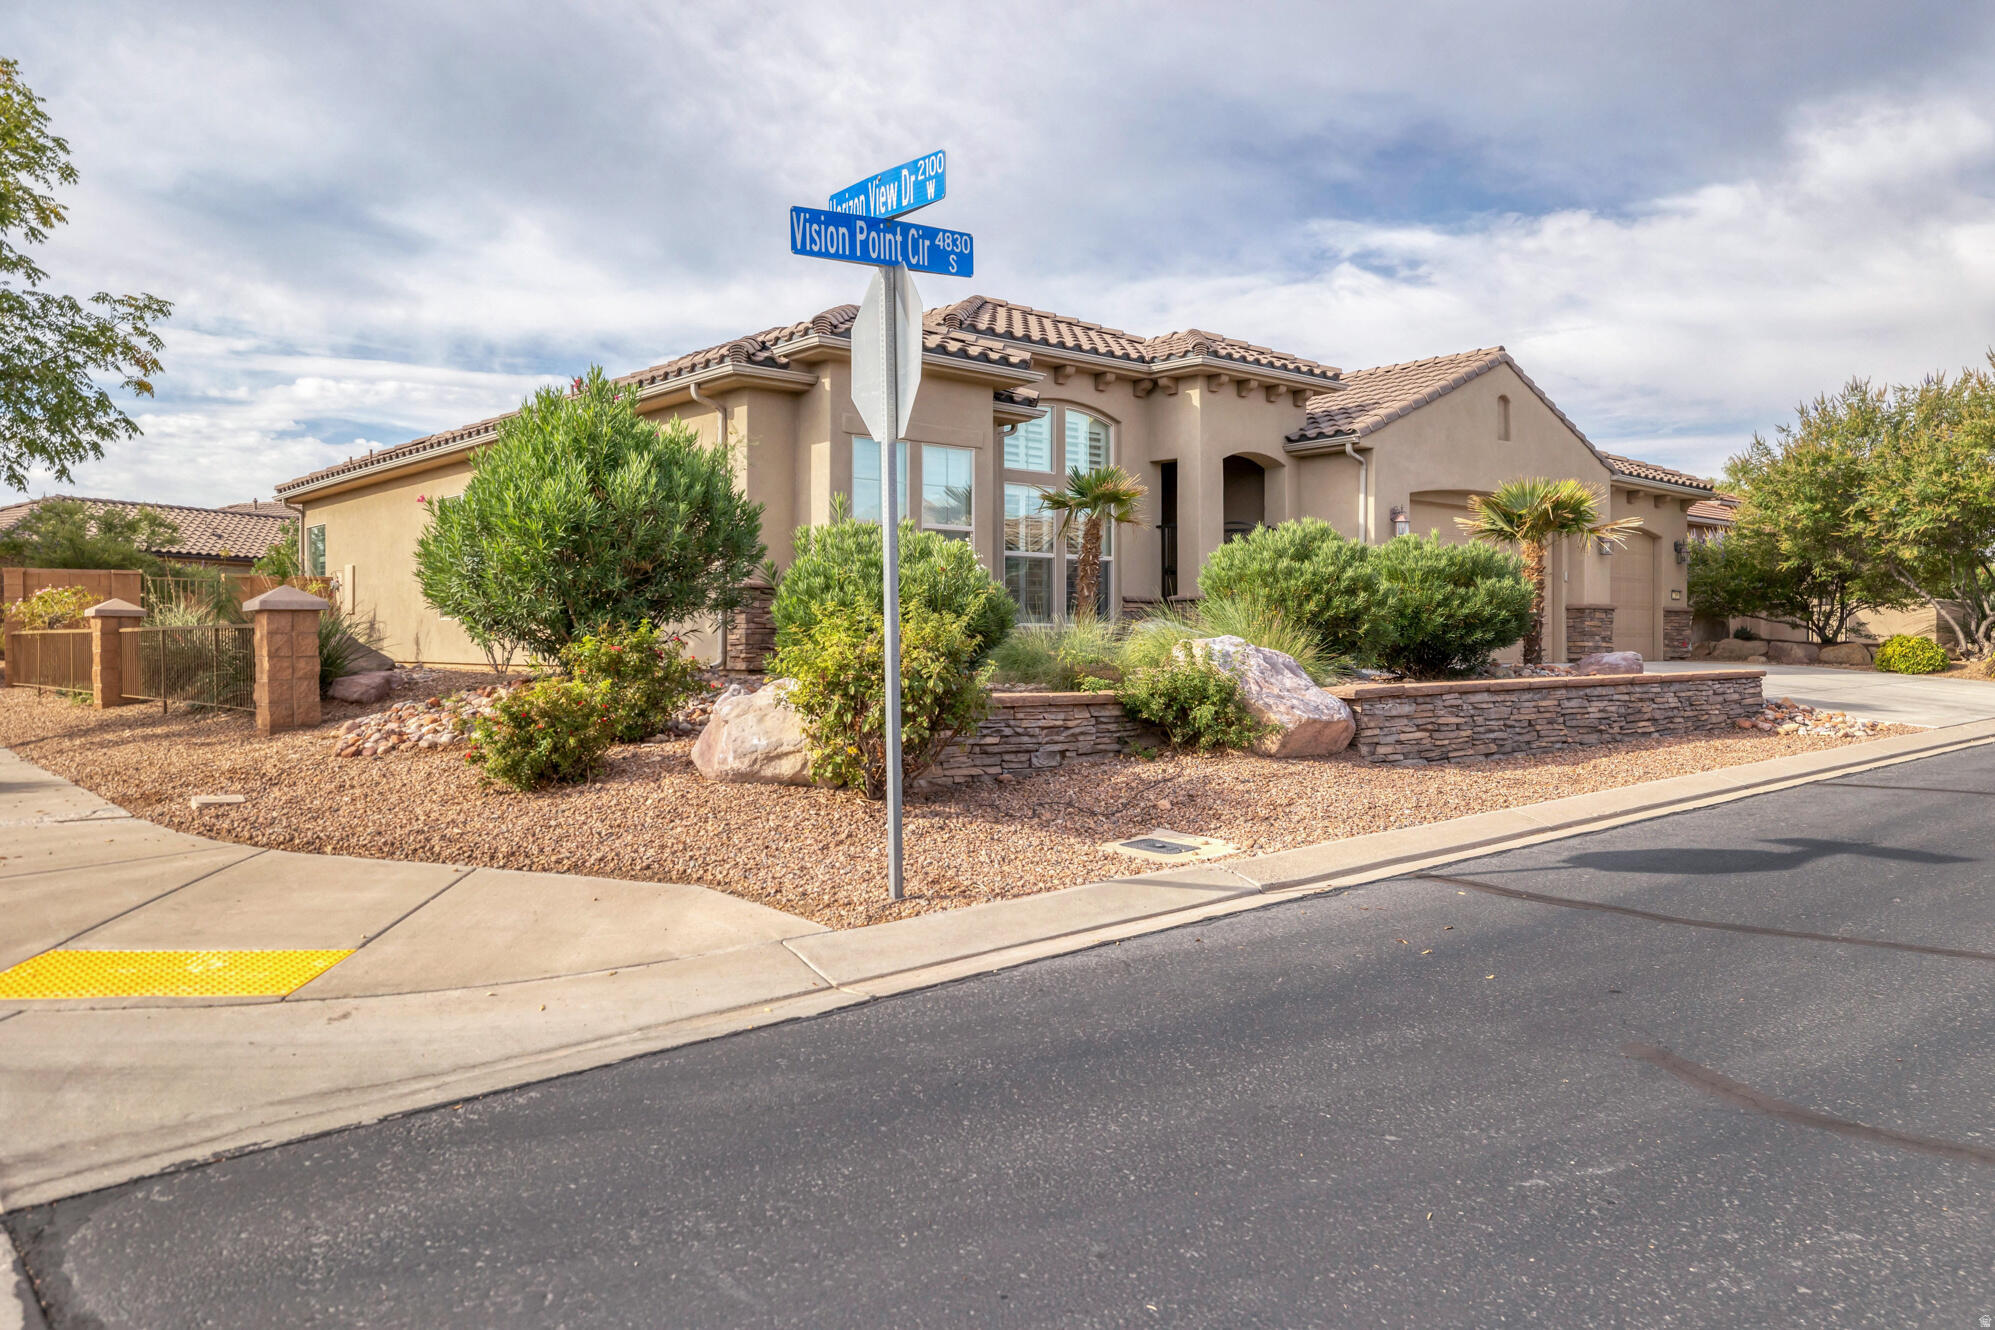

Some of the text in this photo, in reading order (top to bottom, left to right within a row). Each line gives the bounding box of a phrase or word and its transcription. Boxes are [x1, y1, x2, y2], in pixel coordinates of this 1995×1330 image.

[868, 179, 898, 217] View
[901, 168, 916, 207] Dr
[917, 152, 944, 181] 2100
[792, 211, 971, 266] Vision Point Cir 4830
[949, 254, 958, 273] S
